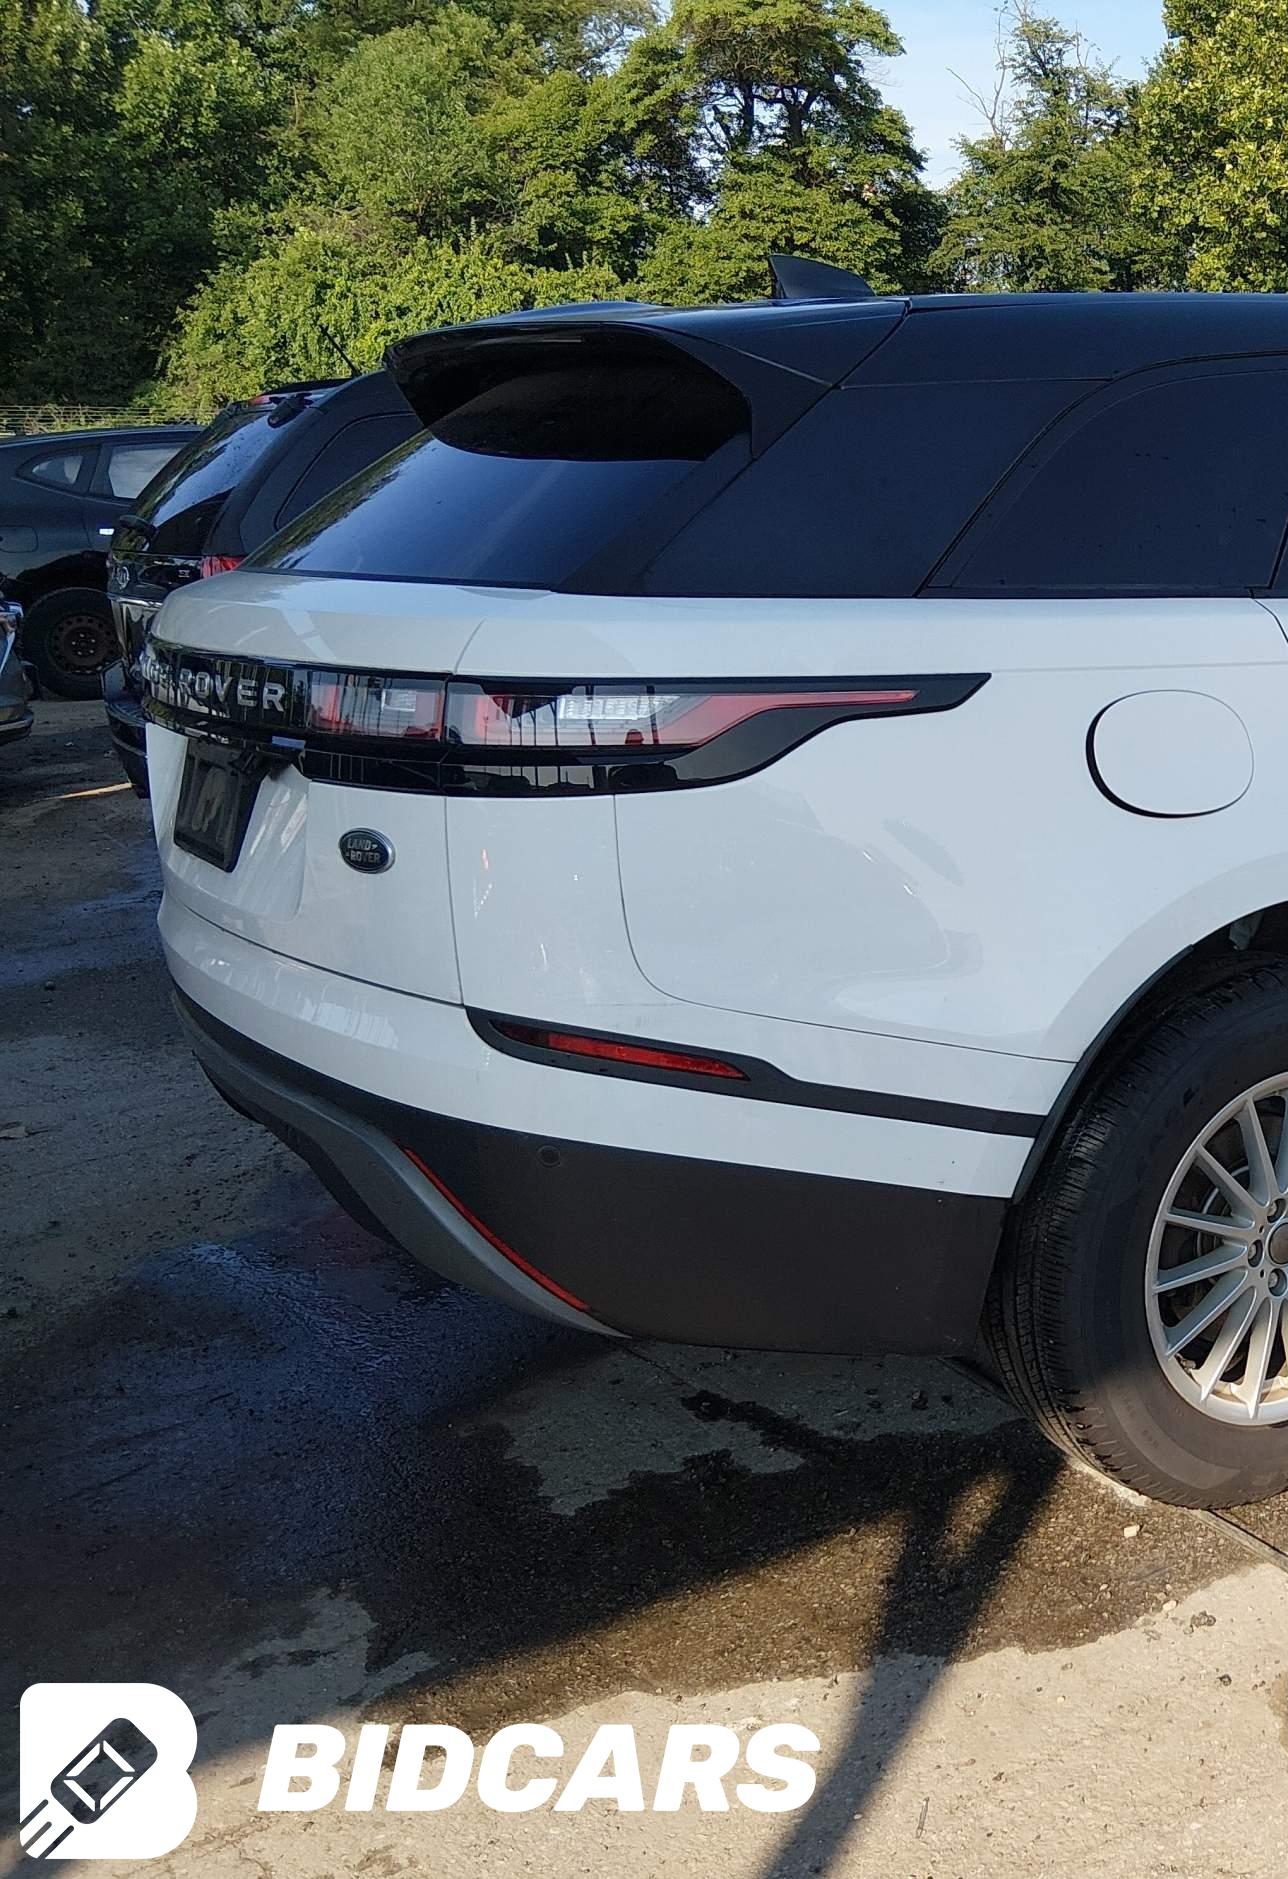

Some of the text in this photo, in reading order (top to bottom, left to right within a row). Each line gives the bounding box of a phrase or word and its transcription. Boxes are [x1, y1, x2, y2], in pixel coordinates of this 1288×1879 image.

[177, 667, 286, 712] ROVER
[347, 838, 372, 851] LAND
[350, 850, 381, 863] ROVER
